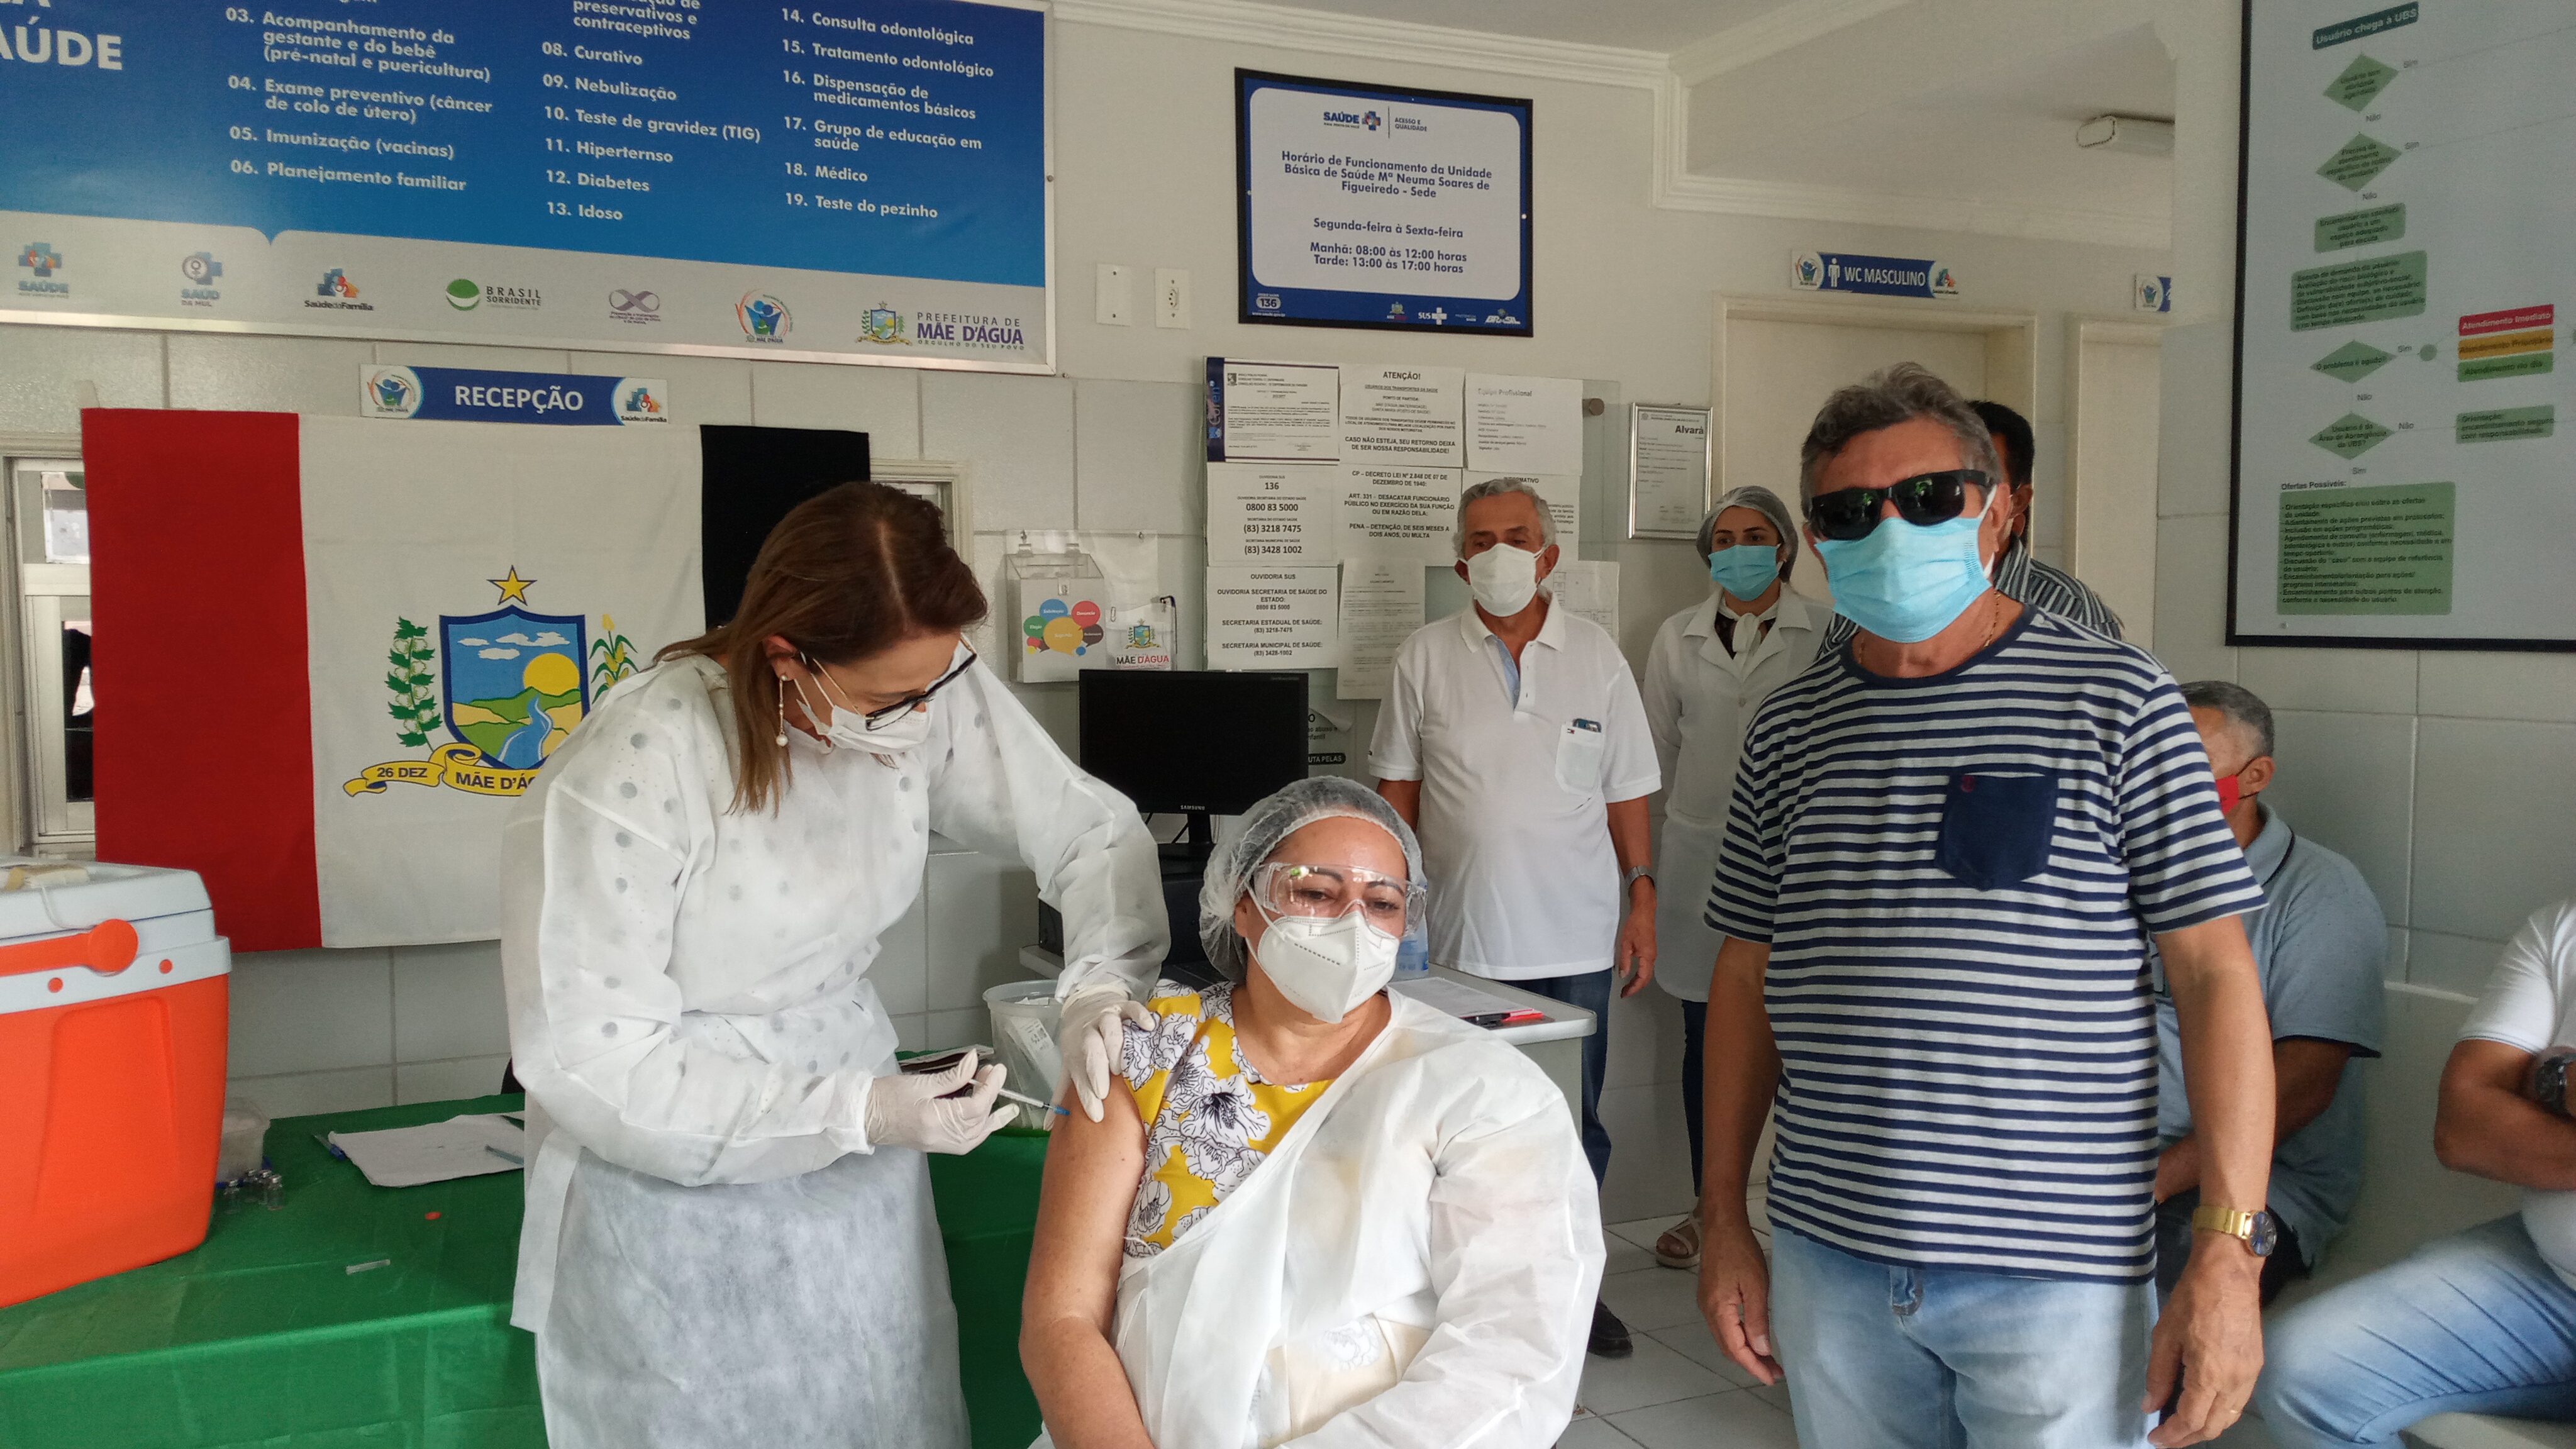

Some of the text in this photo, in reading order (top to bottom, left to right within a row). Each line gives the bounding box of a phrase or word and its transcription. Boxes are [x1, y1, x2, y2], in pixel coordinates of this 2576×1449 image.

[574, 0, 683, 23] preservativos
[688, 15, 697, 25] e
[226, 8, 454, 44] 03. Acompanhamento da
[574, 17, 690, 39] contraceptivos
[782, 8, 974, 45] 14. Consulta odontológica
[2317, 28, 2352, 43] Usuário
[2354, 20, 2384, 33] chega
[2395, 9, 2417, 22] UBS
[263, 31, 436, 58] gestante e do bebê
[542, 42, 643, 65] 08. Curativo
[264, 47, 490, 83] (pré-natal e puericultura)
[782, 39, 994, 77] 15. Tratamento odontológico
[228, 75, 492, 112] 04. Exame preventivo (câncer
[543, 74, 677, 102] 09. Nebulização
[784, 70, 928, 99] 16. Dispensação de
[265, 96, 416, 125] de colo de útero)
[814, 92, 975, 119] medicamentos básicos
[545, 106, 760, 143] 10. Teste de gravidez (TIG)
[1323, 111, 1359, 124] SAÚDE
[1395, 123, 1427, 131] QUALIDADE
[785, 116, 981, 149] 17. Grupo de educação em
[229, 126, 454, 160] 05. Imunização (vacinas)
[546, 138, 673, 163] 11. Hiperternso
[814, 137, 859, 151] saúde
[229, 157, 467, 190] 06. Planejamento familiar
[785, 162, 867, 182] 18. Médico
[1282, 151, 1492, 179] Horário de Funcionamento da Unidade
[547, 170, 649, 191] 12. Diabetes
[1285, 164, 1319, 175] Básica
[1324, 167, 1337, 177] de
[1341, 169, 1375, 180] Saúde
[1397, 173, 1435, 186] Neuma
[1439, 177, 1474, 189] Soares
[1477, 180, 1489, 190] de
[1342, 180, 1399, 194] Figueiredo
[1411, 186, 1436, 197] Sede
[547, 202, 623, 220] 13. Idoso
[786, 192, 938, 218] 19. Teste do pezinho
[1314, 218, 1392, 233] Segunda-feira
[1406, 225, 1463, 238] Sexta-feira
[1311, 242, 1467, 262] Manhã: 08:00 às 12:00 horas
[1314, 254, 1463, 273] Tarde: 13:00 às 17:00 horas
[1844, 267, 1926, 286] WC MASCULINO
[487, 286, 541, 299] BRASIL
[487, 296, 541, 306] SORRIDENTE
[1260, 298, 1277, 307] 136
[918, 312, 1019, 327] PREFEITURA DE
[2462, 312, 2551, 330] Atendimento Imediato
[917, 322, 955, 340] MÃE
[1383, 372, 1420, 380] ATENÇÃO!
[455, 386, 583, 414] RECEPÇÃO
[1675, 425, 1704, 434] Alvará
[2309, 480, 2346, 488] Possíveis:
[1244, 525, 1259, 534] (83)
[1245, 546, 1260, 555] (83)
[1116, 655, 1136, 665] MÃE
[377, 767, 428, 777] 26 DEZ
[456, 772, 494, 789] MÃE
